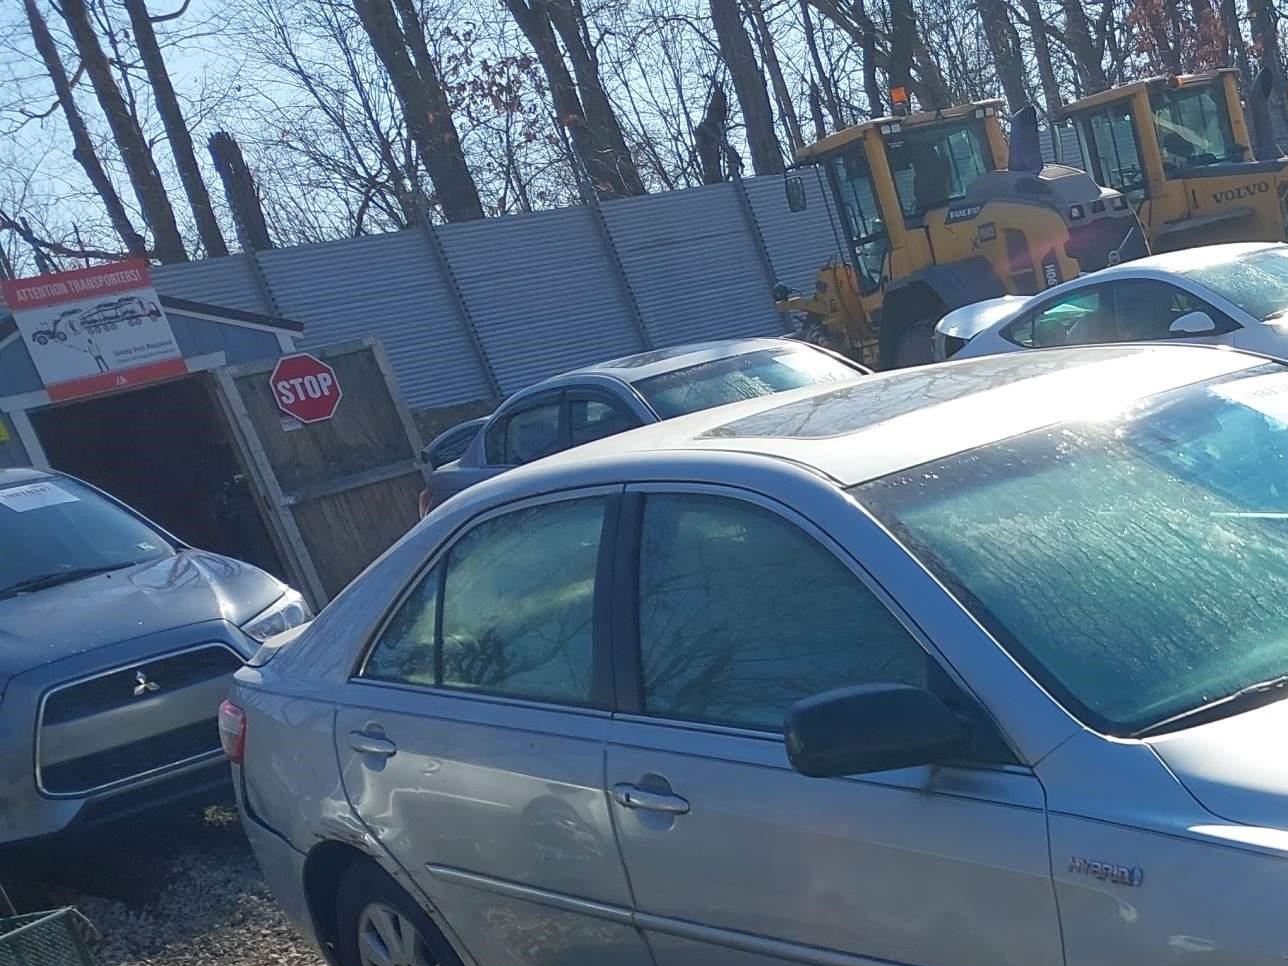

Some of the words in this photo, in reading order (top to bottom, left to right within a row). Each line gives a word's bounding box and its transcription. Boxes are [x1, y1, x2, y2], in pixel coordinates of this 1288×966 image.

[1212, 181, 1269, 204] VOLVO
[16, 281, 68, 302] ATTENTION
[69, 269, 142, 294] TRANSPORTERS!
[277, 373, 332, 404] STOP
